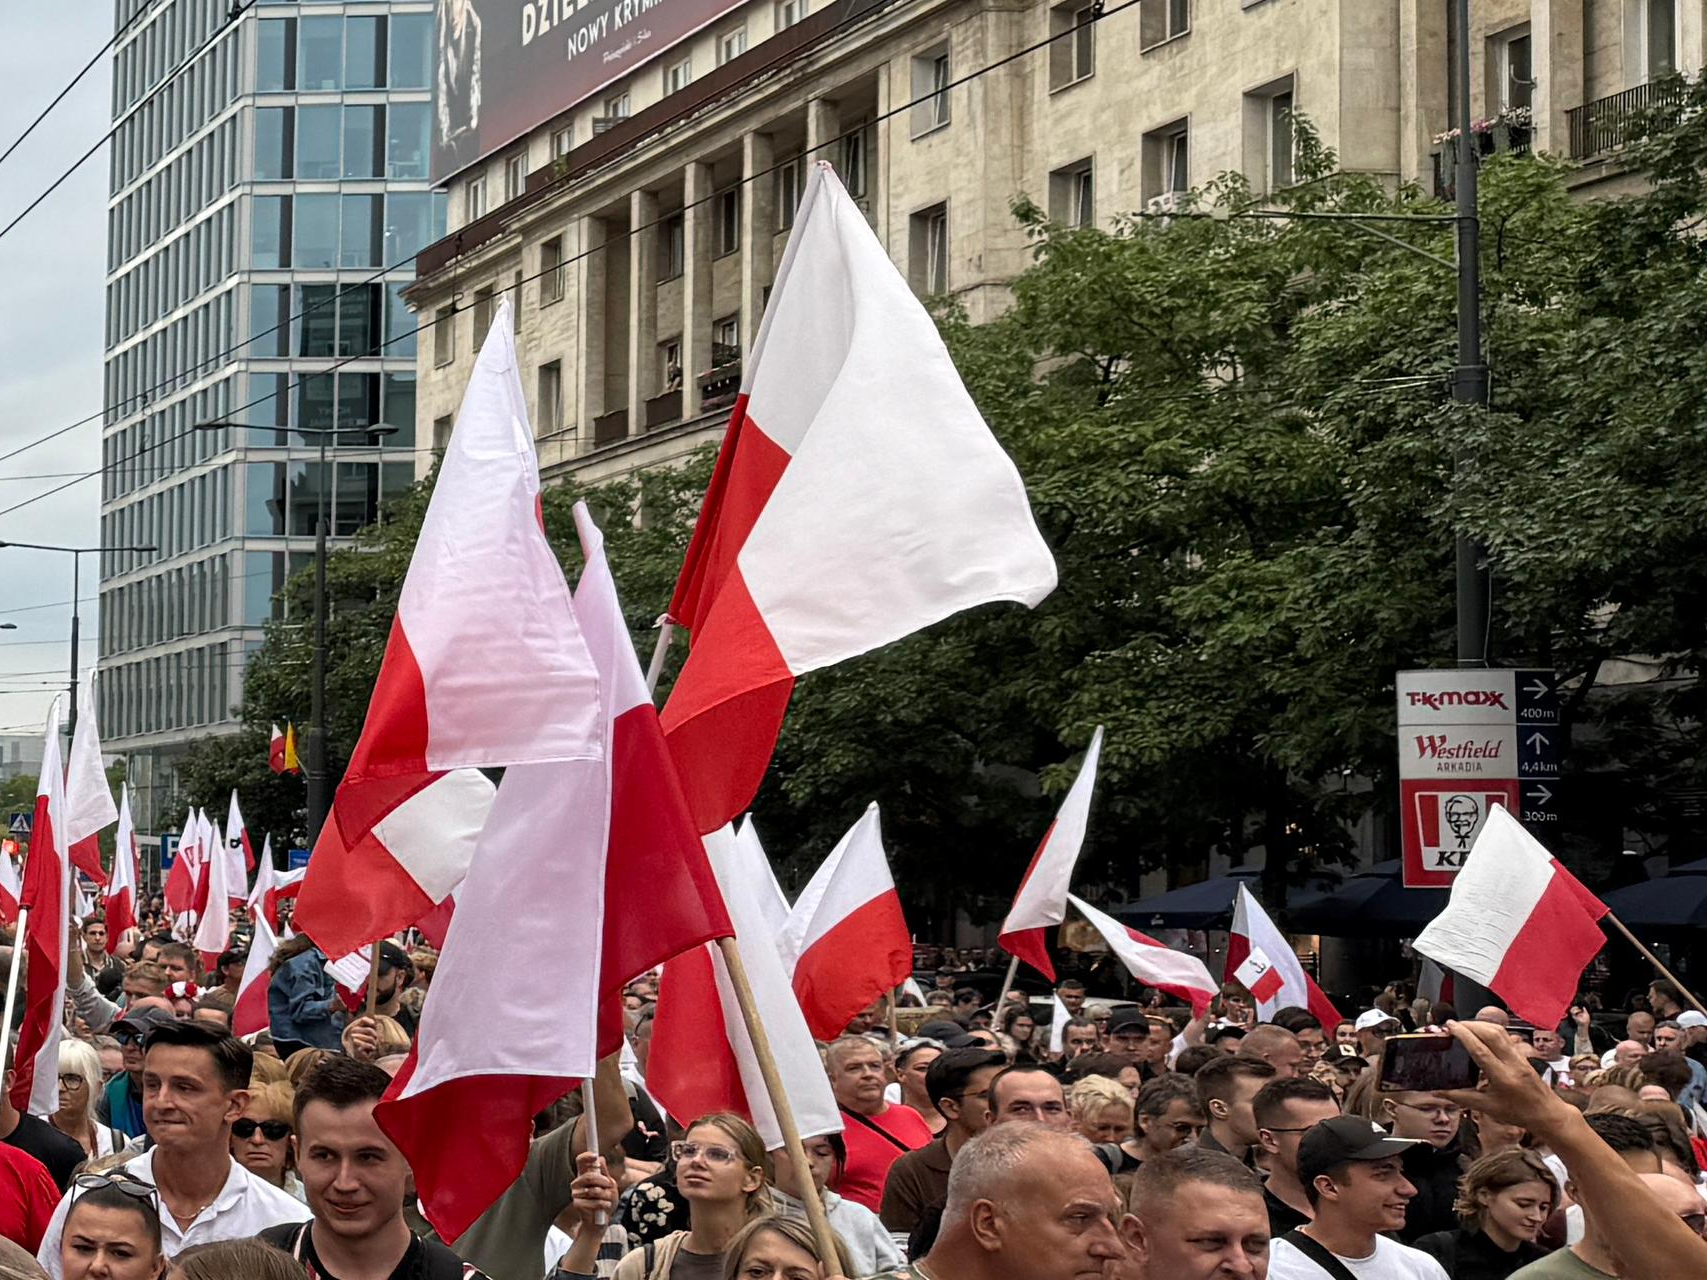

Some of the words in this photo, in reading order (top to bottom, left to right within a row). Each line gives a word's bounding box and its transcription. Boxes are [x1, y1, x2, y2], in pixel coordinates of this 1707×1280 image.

[568, 11, 609, 61] NOWY
[1414, 733, 1503, 760] Westfield
[1436, 762, 1483, 772] ARKADIA
